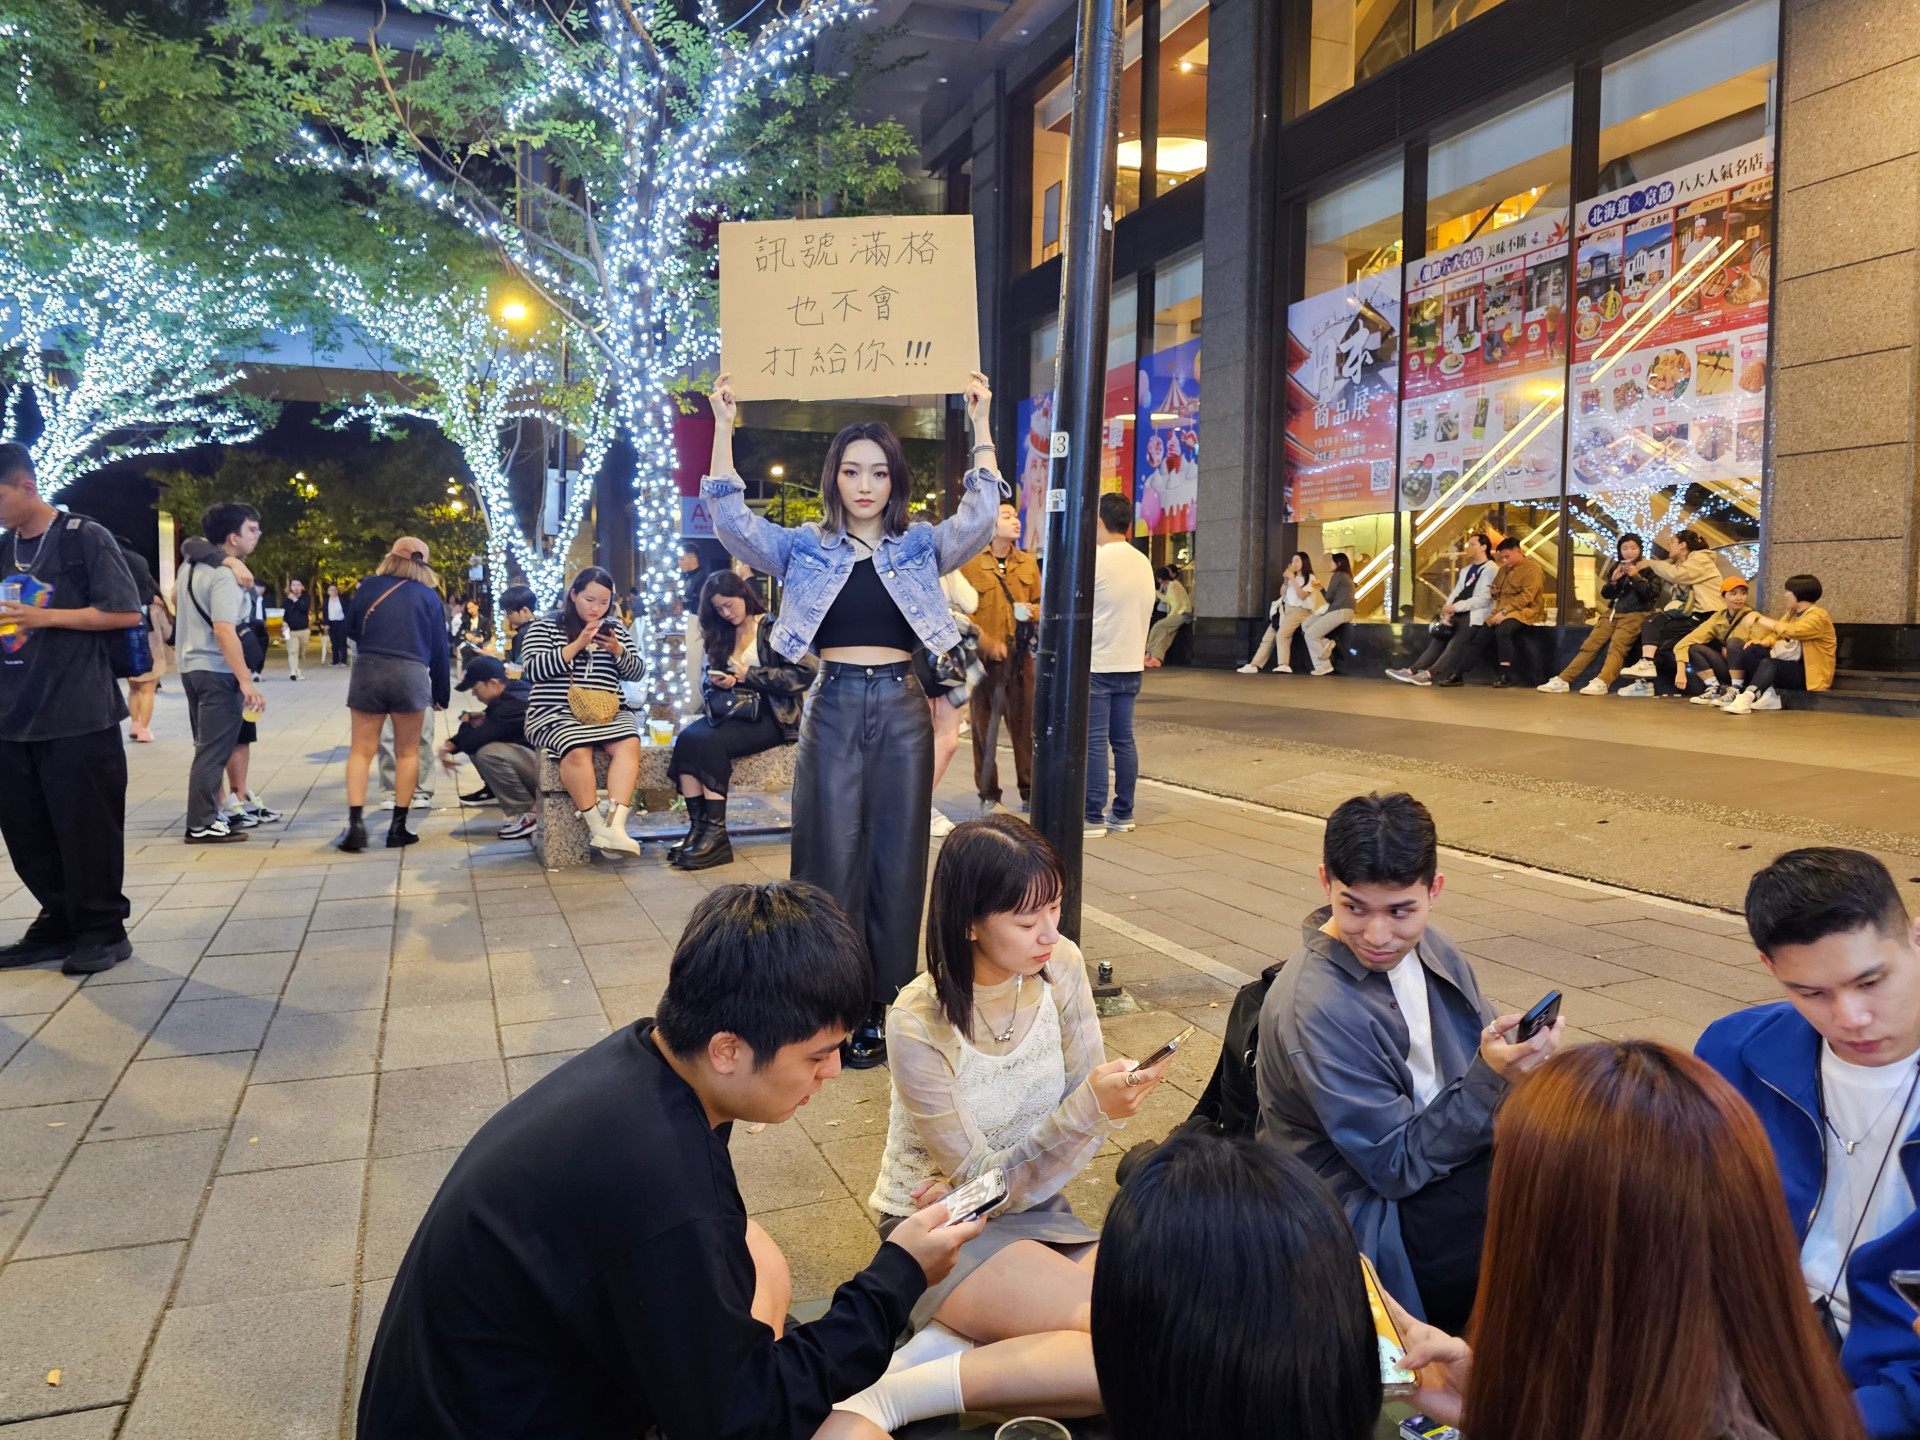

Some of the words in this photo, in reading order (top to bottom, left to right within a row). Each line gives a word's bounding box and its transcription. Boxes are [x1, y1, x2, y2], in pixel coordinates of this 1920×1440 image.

[1677, 152, 1764, 195] 八大人氣名店
[754, 230, 939, 273] 訊號滿格
[1486, 234, 1527, 261] 美味不斷
[786, 285, 899, 327] 也不會
[1312, 388, 1371, 431] 商品展
[691, 503, 712, 523] A
